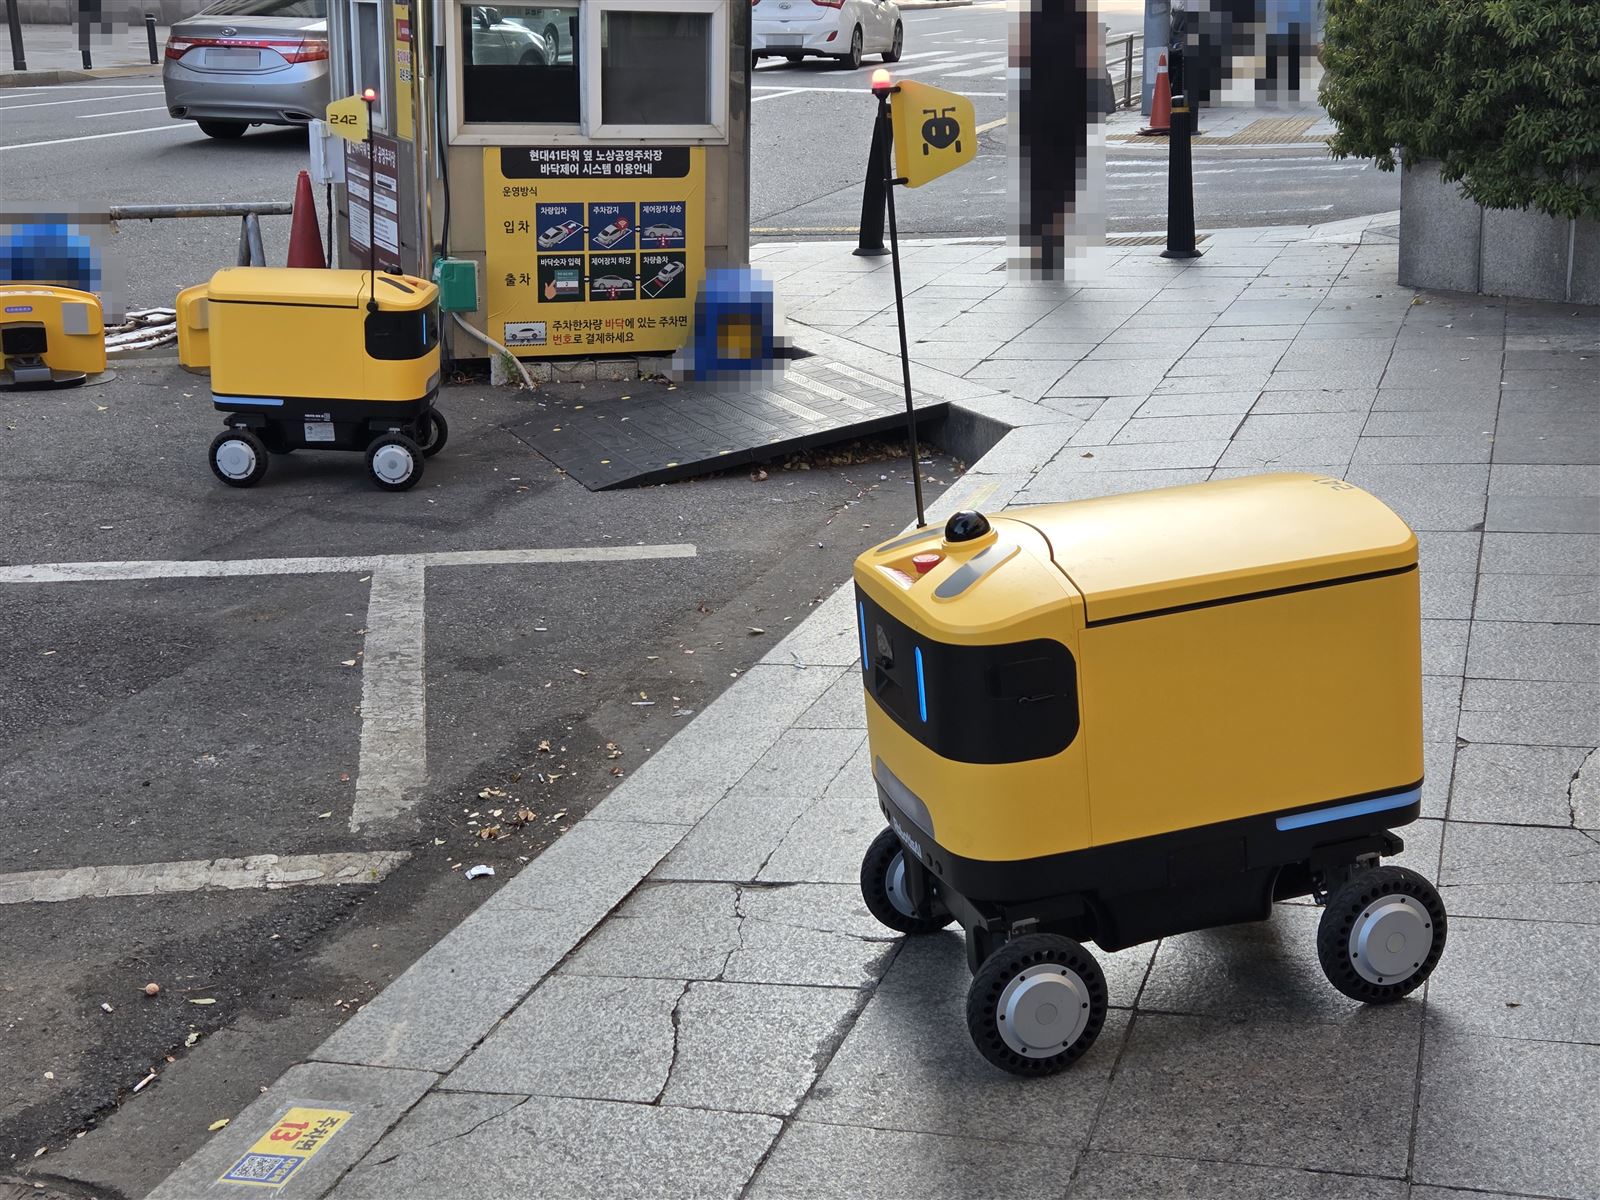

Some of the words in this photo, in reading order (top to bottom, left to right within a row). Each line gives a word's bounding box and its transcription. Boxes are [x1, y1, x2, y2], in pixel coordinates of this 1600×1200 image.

[330, 114, 357, 125] 242
[529, 149, 580, 161] 현대41타워
[583, 149, 593, 162] 옆
[596, 149, 663, 161] 노상공영주차장
[540, 163, 579, 175] 바닥제어
[582, 163, 611, 175] 시스템
[614, 163, 653, 175] 이용안내
[502, 186, 538, 197] 운영방식
[540, 206, 567, 215] 차량입차
[593, 206, 620, 214] 주차감지
[642, 205, 668, 214] 제어장치
[567, 257, 581, 266] 입력
[591, 257, 617, 266] 제어장치
[552, 319, 603, 331] 주차한차량
[604, 318, 635, 330] 바닥에
[637, 317, 657, 329] 있는
[658, 316, 688, 328] 주차면
[552, 333, 583, 346] 번호로
[585, 332, 635, 345] 결제하세요
[269, 1121, 310, 1142] 13
[291, 1116, 341, 1150] 주차면
